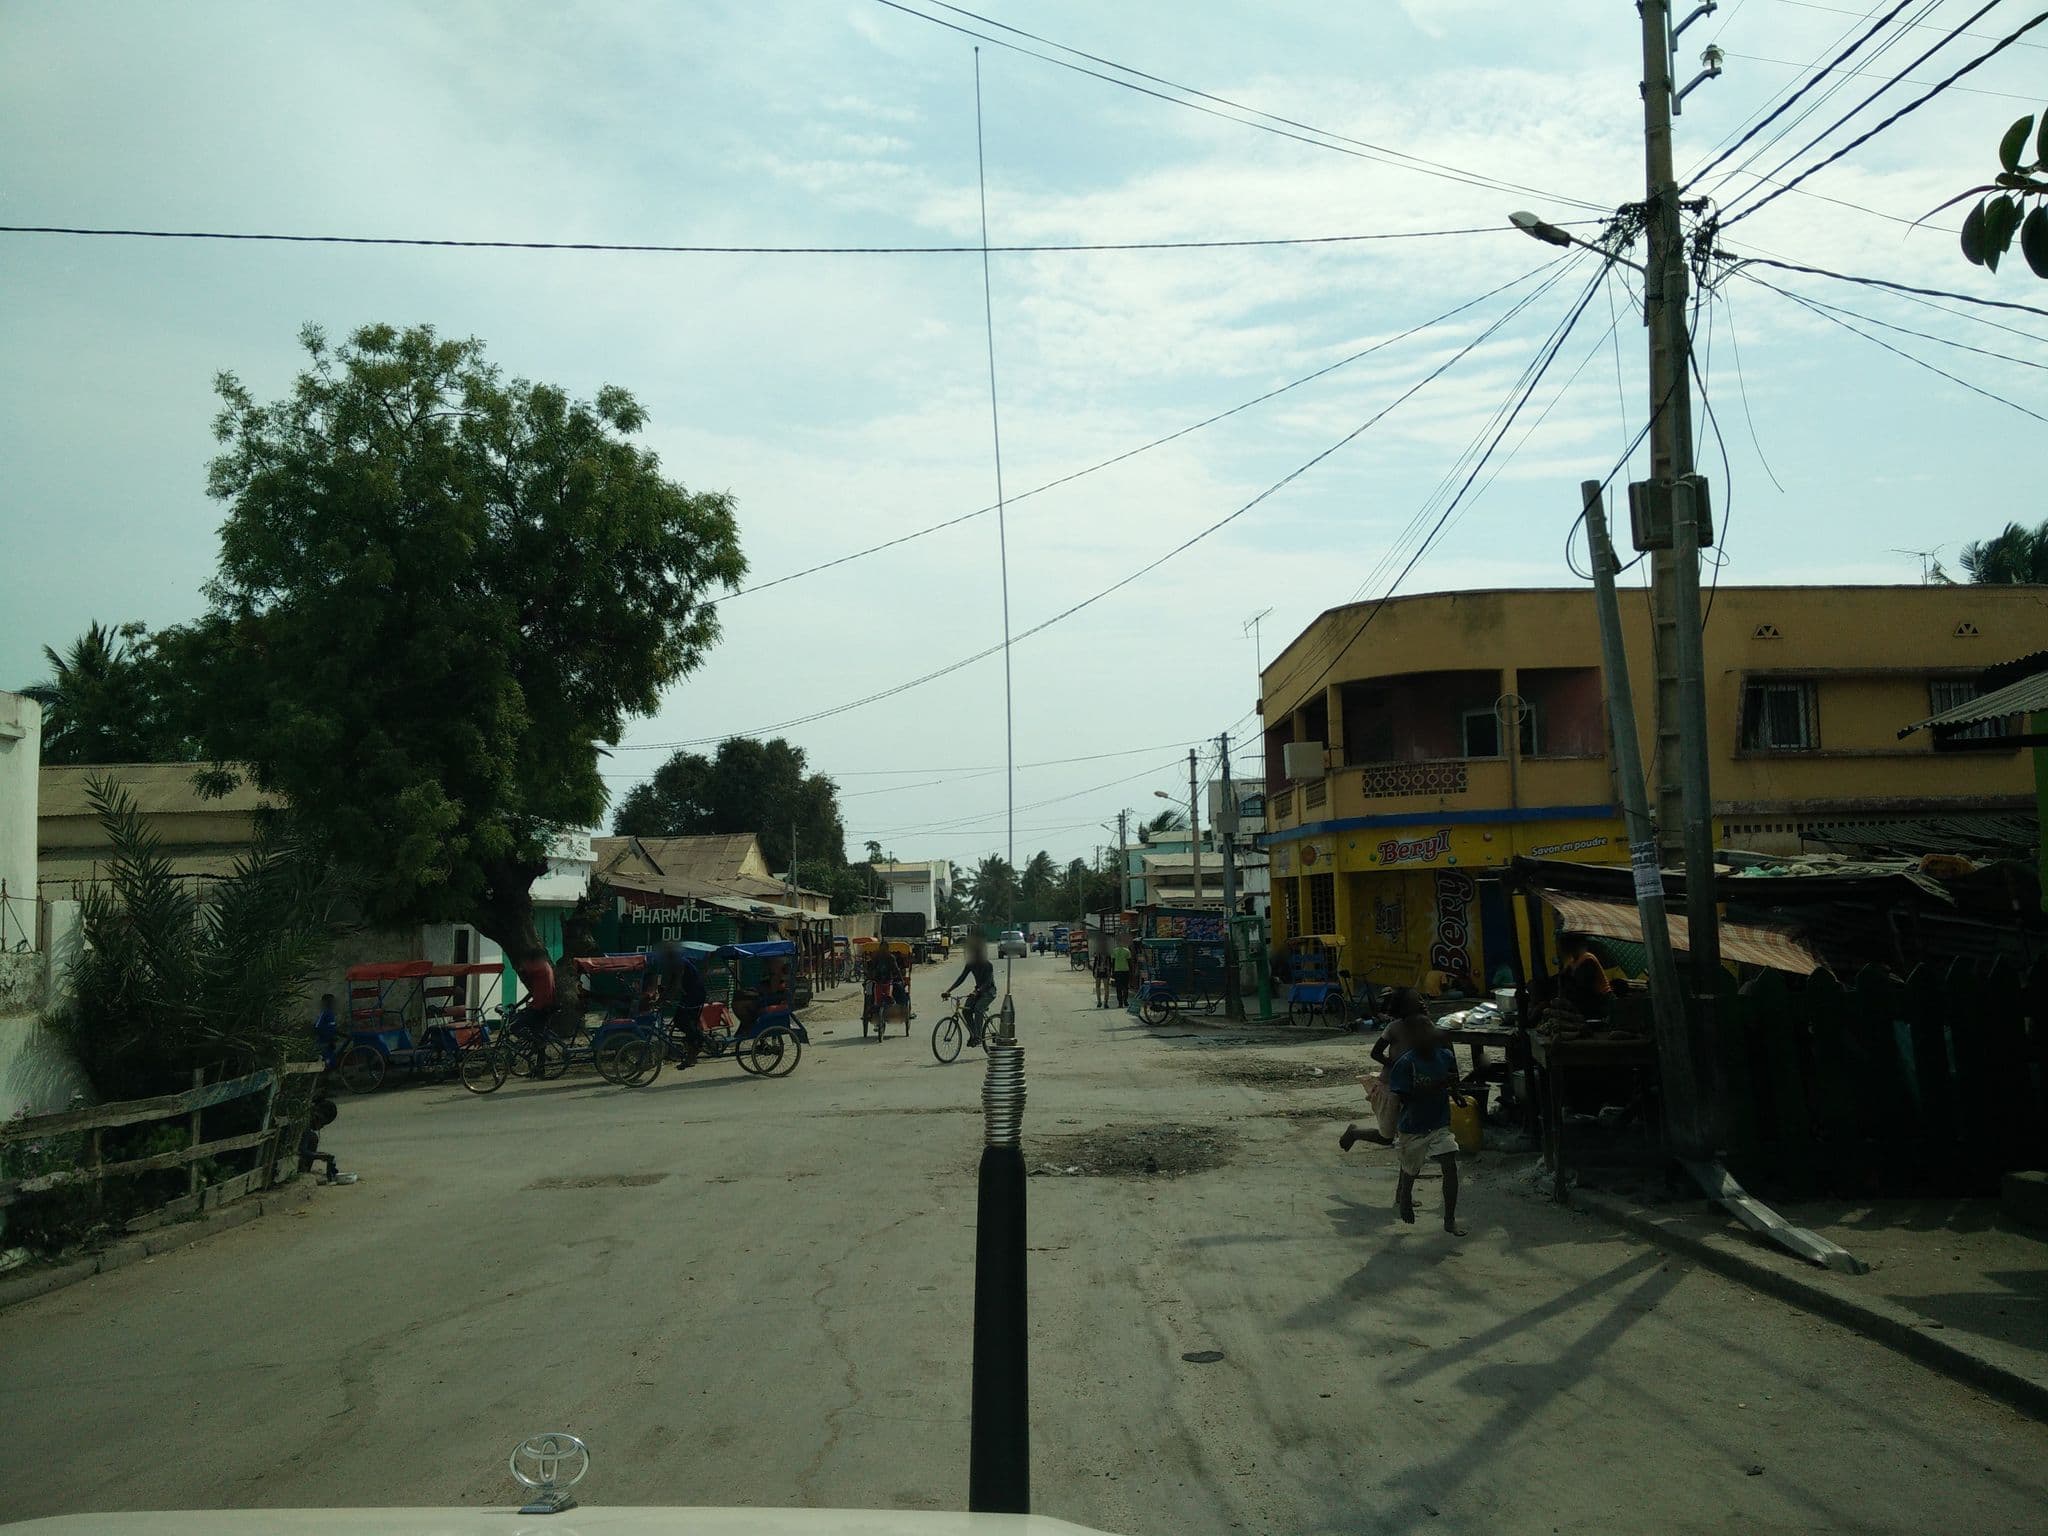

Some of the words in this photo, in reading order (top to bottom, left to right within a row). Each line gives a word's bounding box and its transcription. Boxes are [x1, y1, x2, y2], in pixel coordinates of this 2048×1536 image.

[1377, 830, 1450, 864] Beryl
[1532, 845, 1560, 856] Savon
[1562, 843, 1573, 852] en
[1573, 837, 1607, 852] poudre
[632, 907, 713, 924] PHARMACIE
[1430, 868, 1475, 976] Bery
[662, 927, 682, 940] DU
